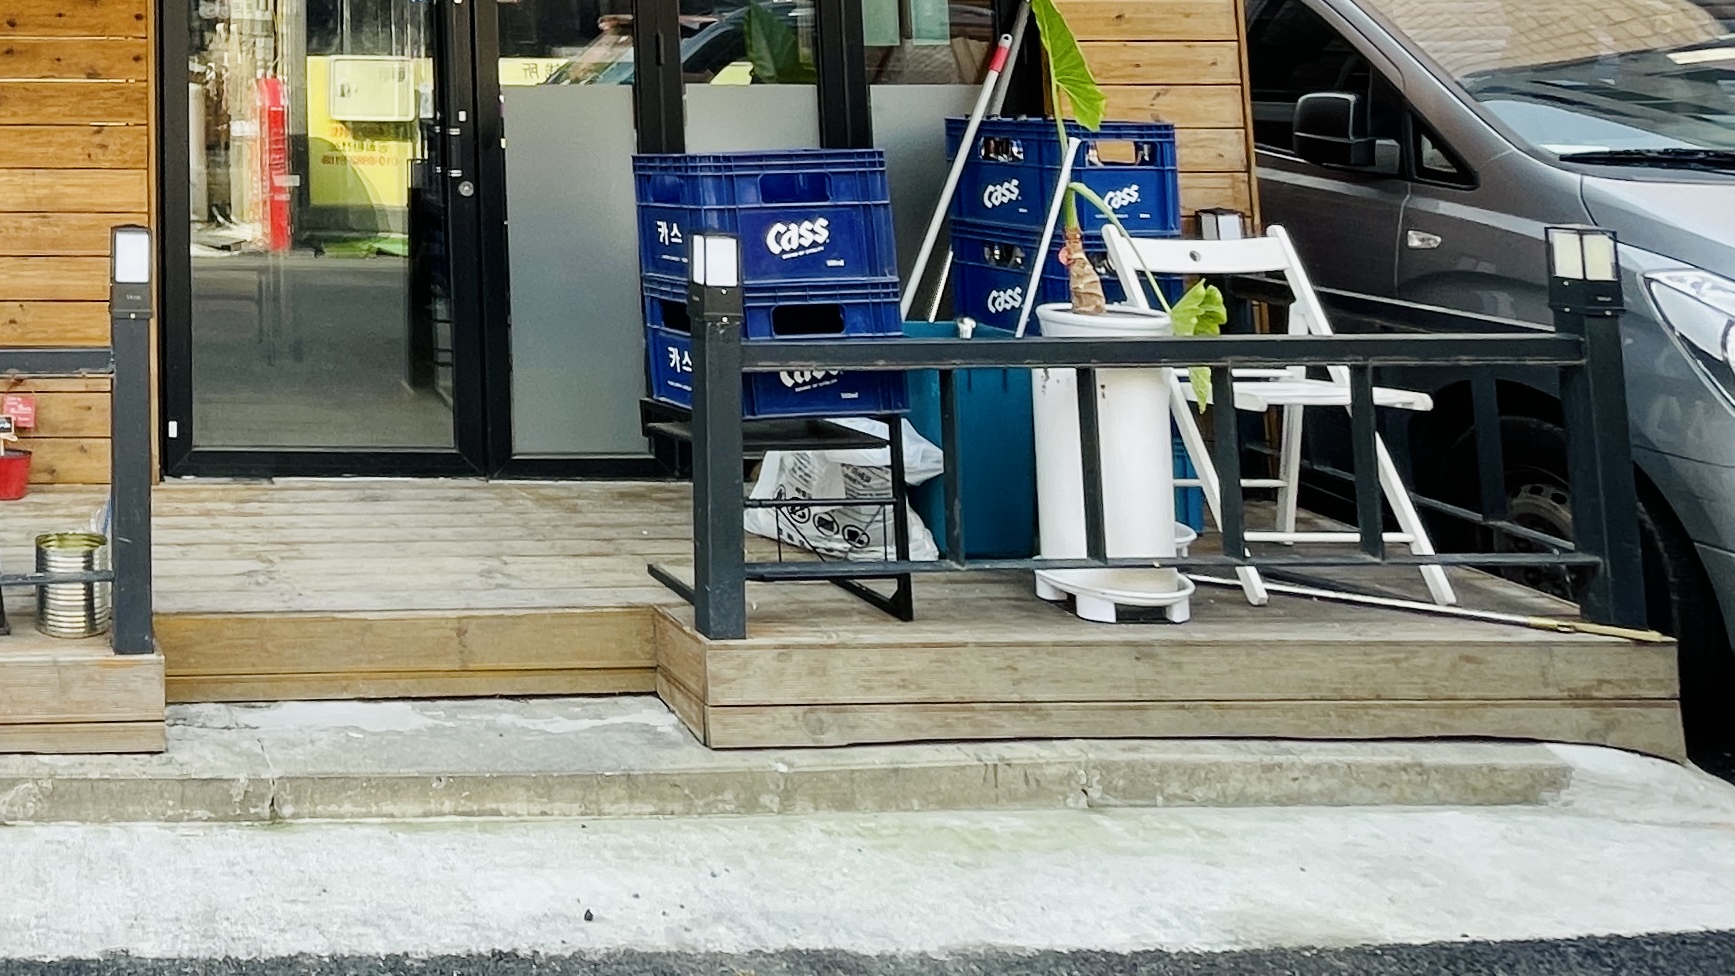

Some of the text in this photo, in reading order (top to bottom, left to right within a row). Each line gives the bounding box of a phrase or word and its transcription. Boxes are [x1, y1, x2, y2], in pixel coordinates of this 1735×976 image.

[984, 179, 1020, 208] Cass
[656, 220, 683, 246] 카스
[766, 217, 829, 255] Cass
[987, 286, 1023, 314] Cass
[668, 346, 693, 373] 카스
